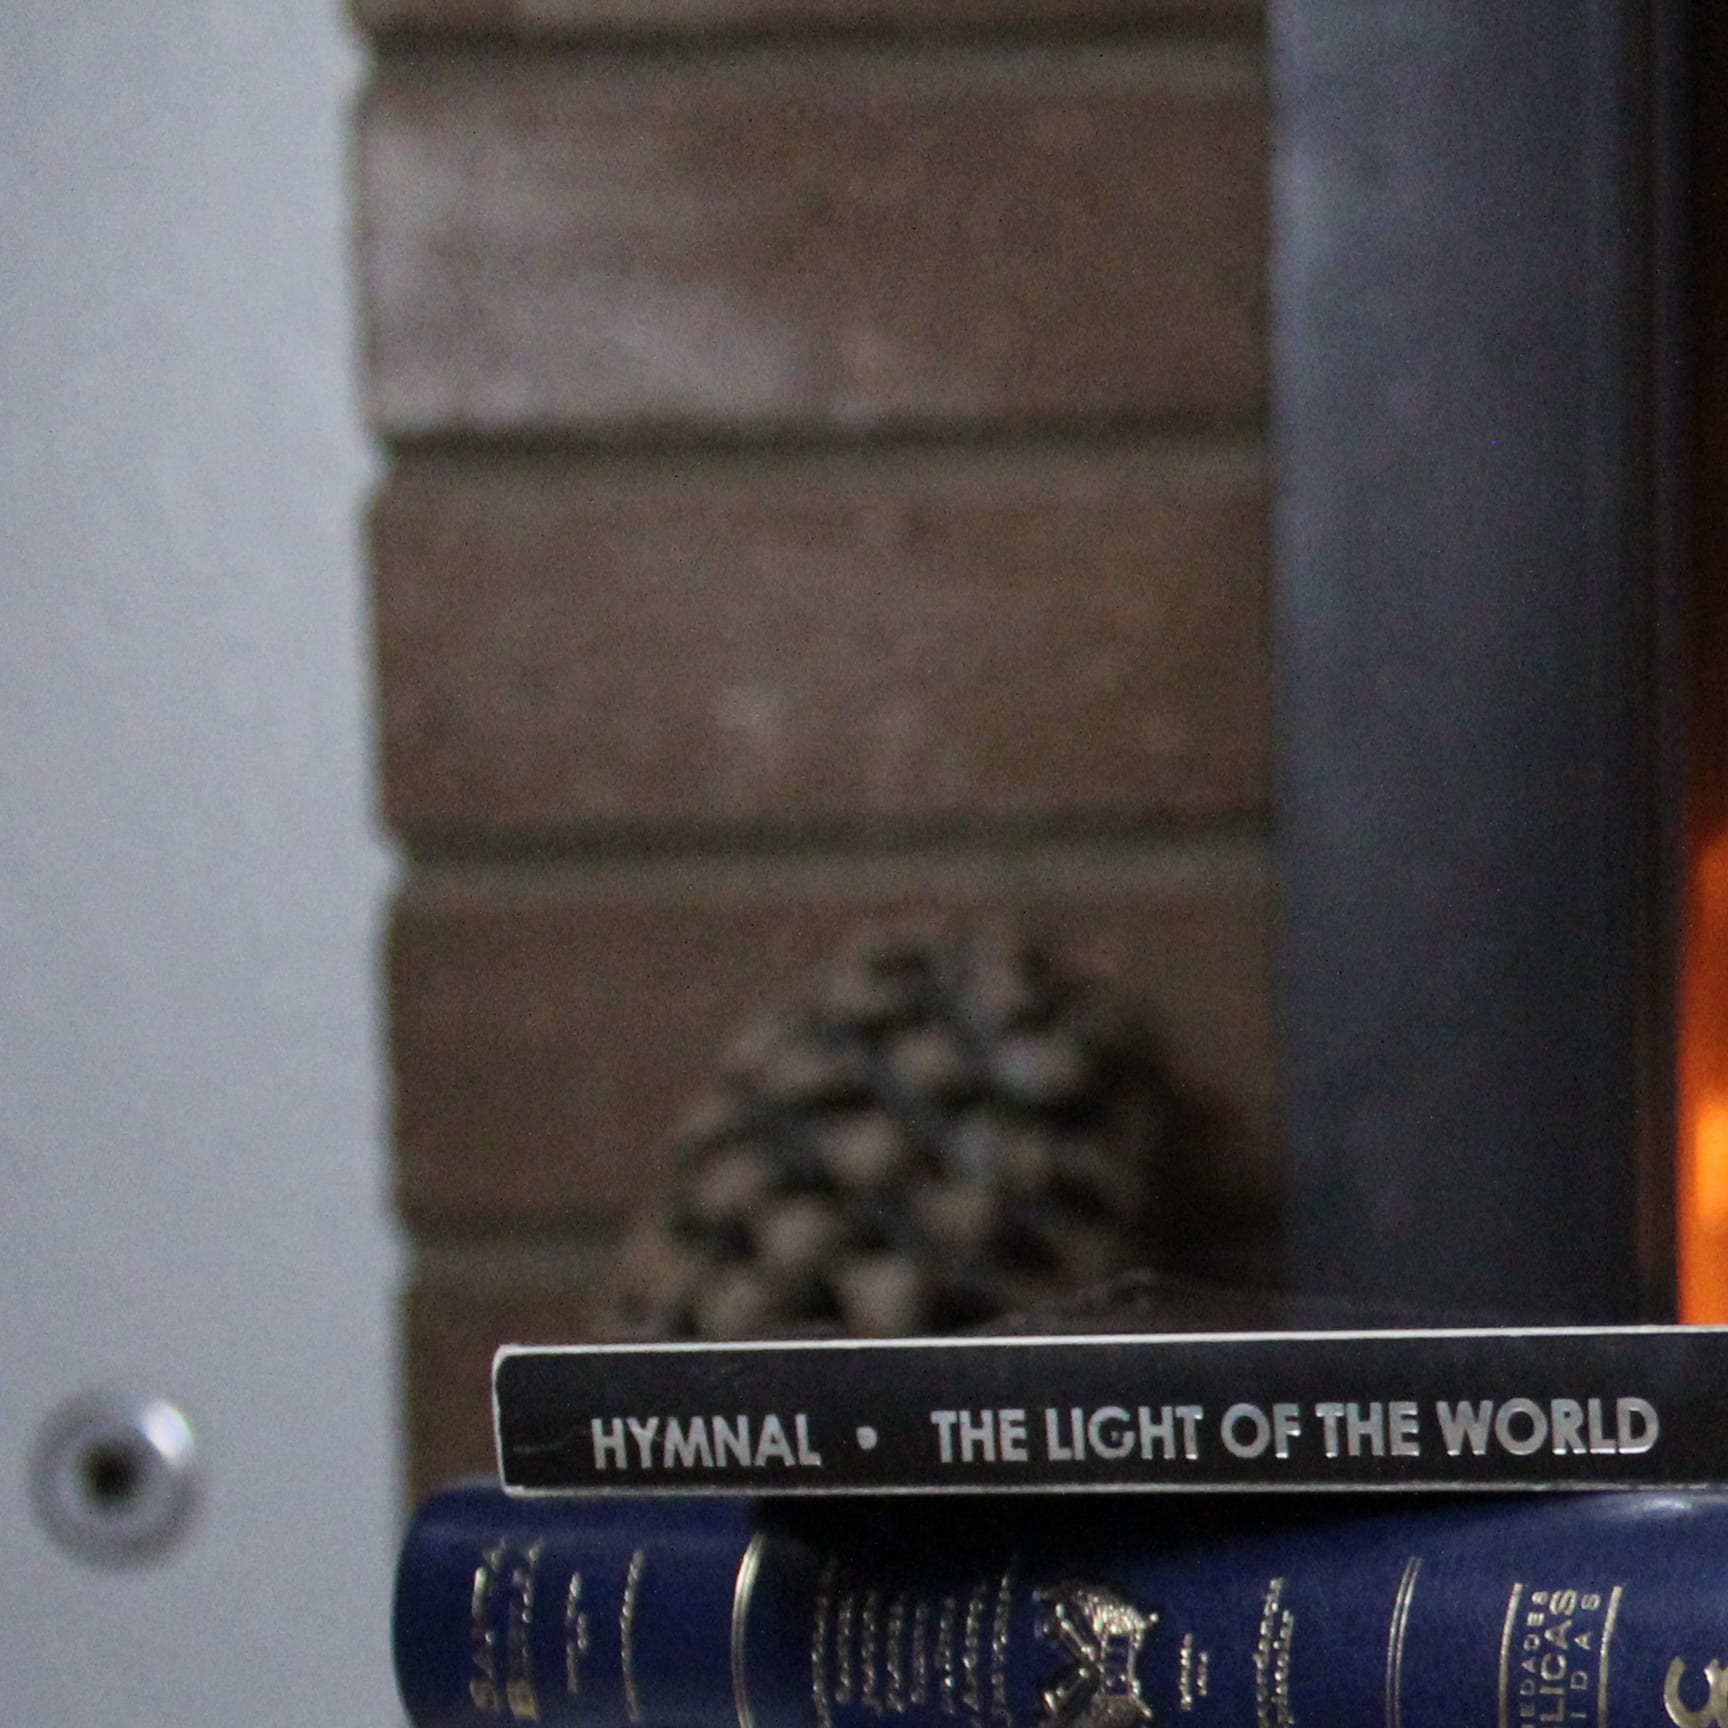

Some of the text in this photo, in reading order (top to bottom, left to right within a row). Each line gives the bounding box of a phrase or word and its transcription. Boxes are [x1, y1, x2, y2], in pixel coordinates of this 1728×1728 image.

[591, 1411, 821, 1471] HYMNAL
[930, 1396, 1659, 1464] THE LIGHT OF THE WORLD
